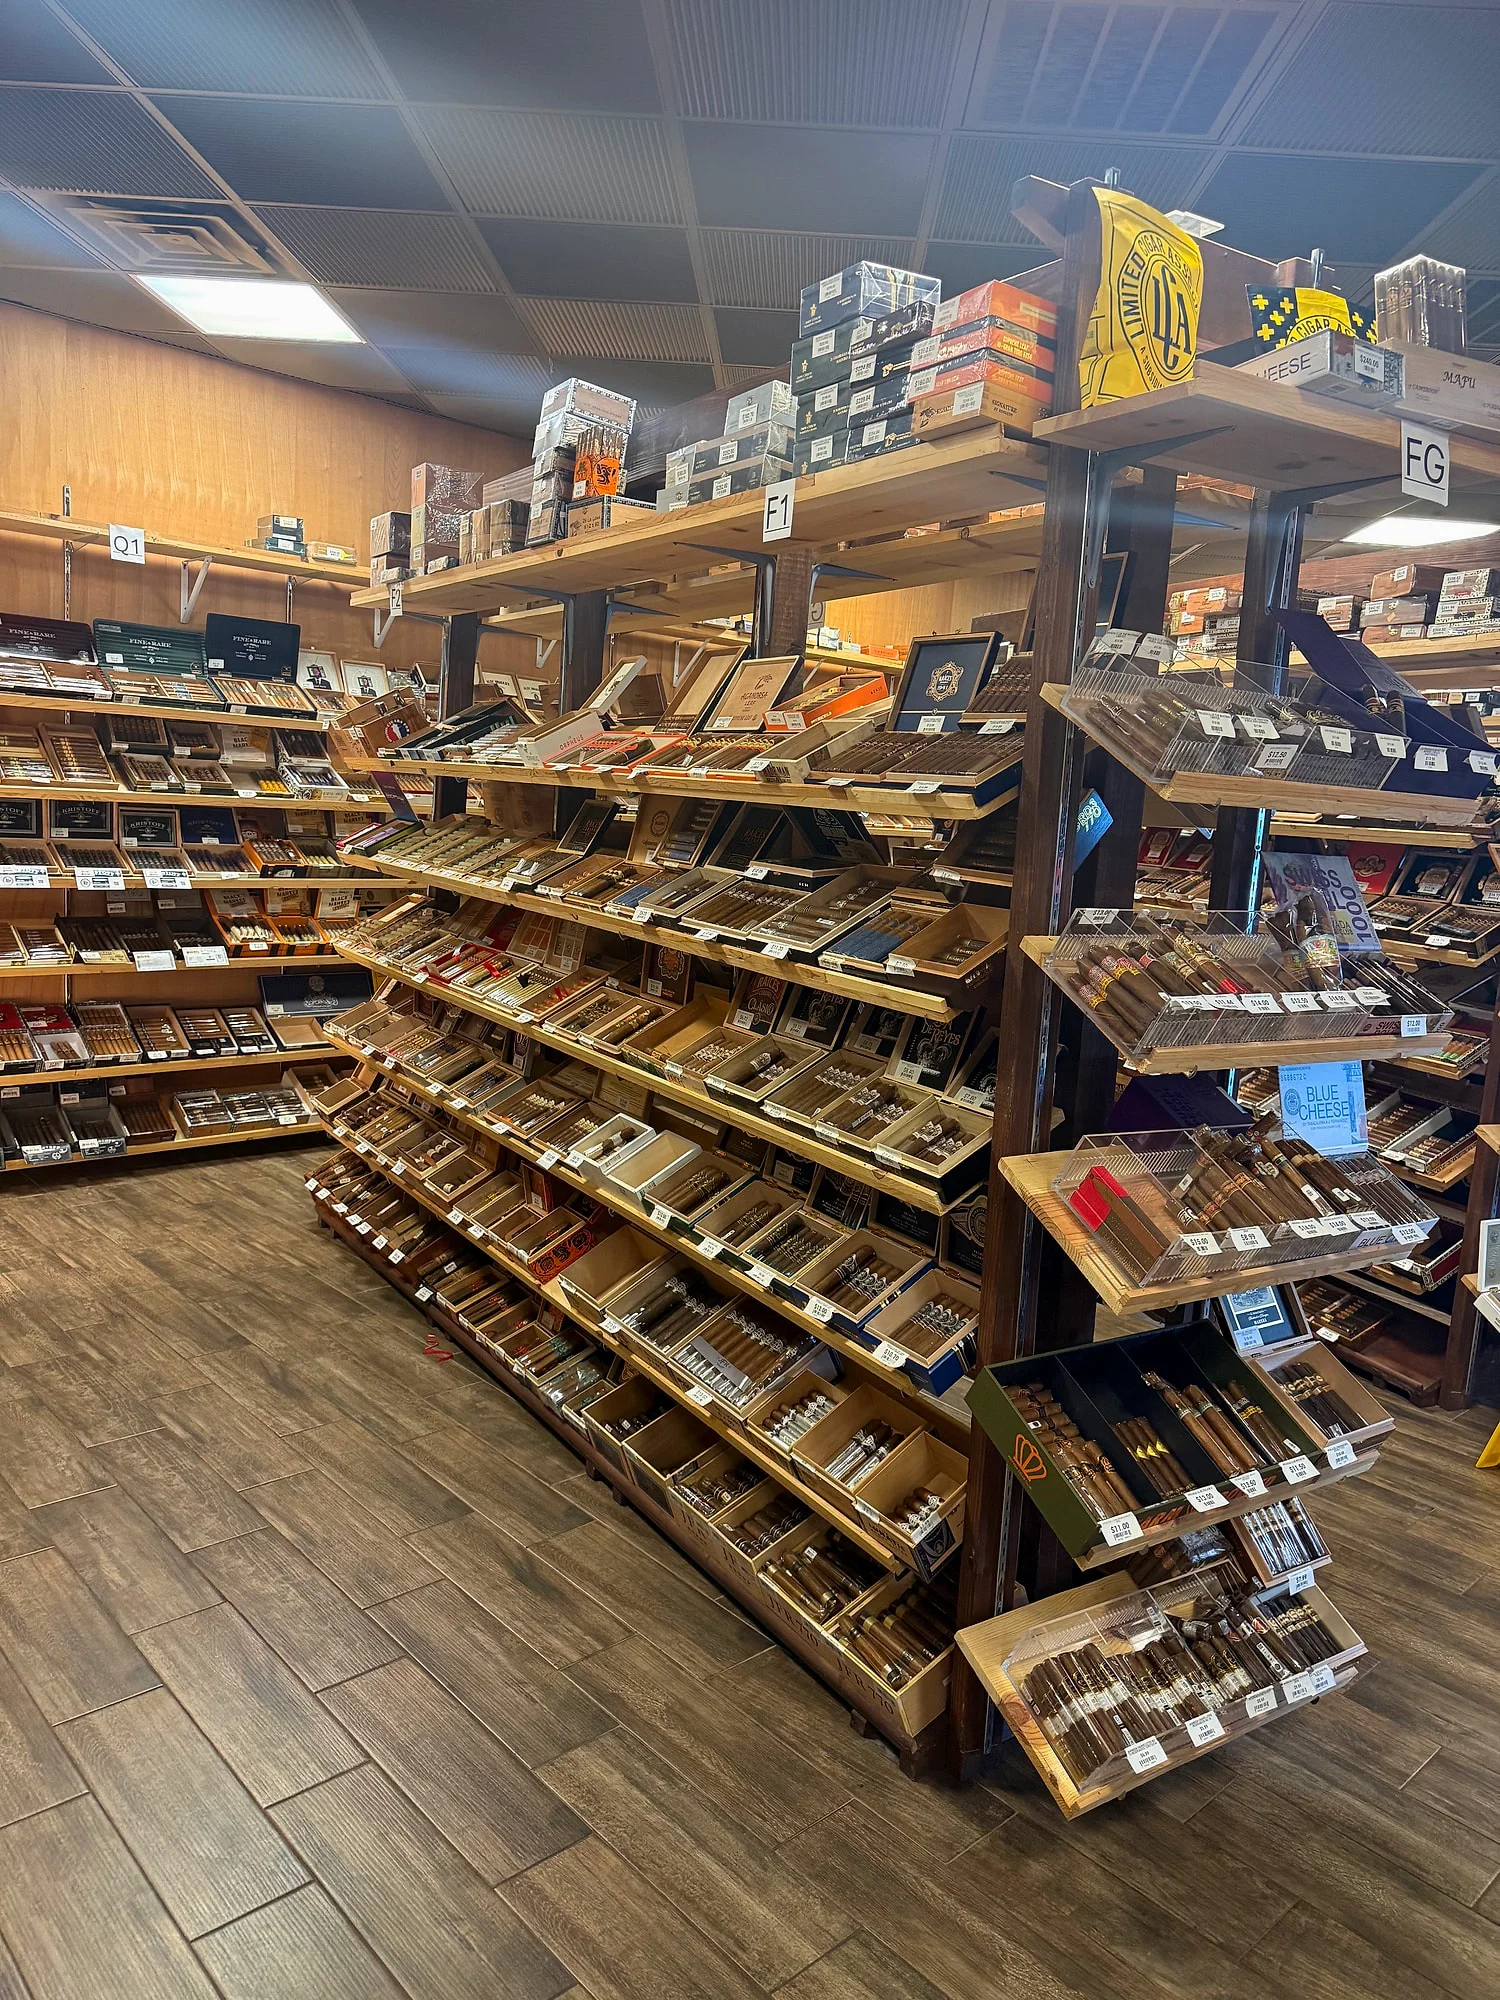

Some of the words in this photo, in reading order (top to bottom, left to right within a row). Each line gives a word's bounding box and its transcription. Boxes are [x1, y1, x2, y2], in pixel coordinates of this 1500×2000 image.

[1121, 253, 1145, 339] LIMITED
[1137, 234, 1165, 257] CIGAR
[1257, 352, 1312, 382] EESE
[1443, 370, 1476, 389] MAFU
[1406, 436, 1445, 484] FG
[766, 494, 789, 529] F1
[113, 535, 139, 556] Q1
[391, 589, 401, 606] F2
[560, 735, 584, 750] ORPHEUS
[1267, 751, 1287, 759] $12.50
[62, 806, 99, 815] KRISTOFF
[130, 820, 165, 829] KRISTOFF
[1375, 1021, 1402, 1030] SWIS
[930, 1028, 961, 1046] REYES
[1306, 1084, 1339, 1102] BLUE
[1299, 1101, 1350, 1121] CHEESE
[1289, 1463, 1307, 1474] $11.50
[1195, 1493, 1214, 1503] $13.00
[1110, 1522, 1130, 1534] $11.00
